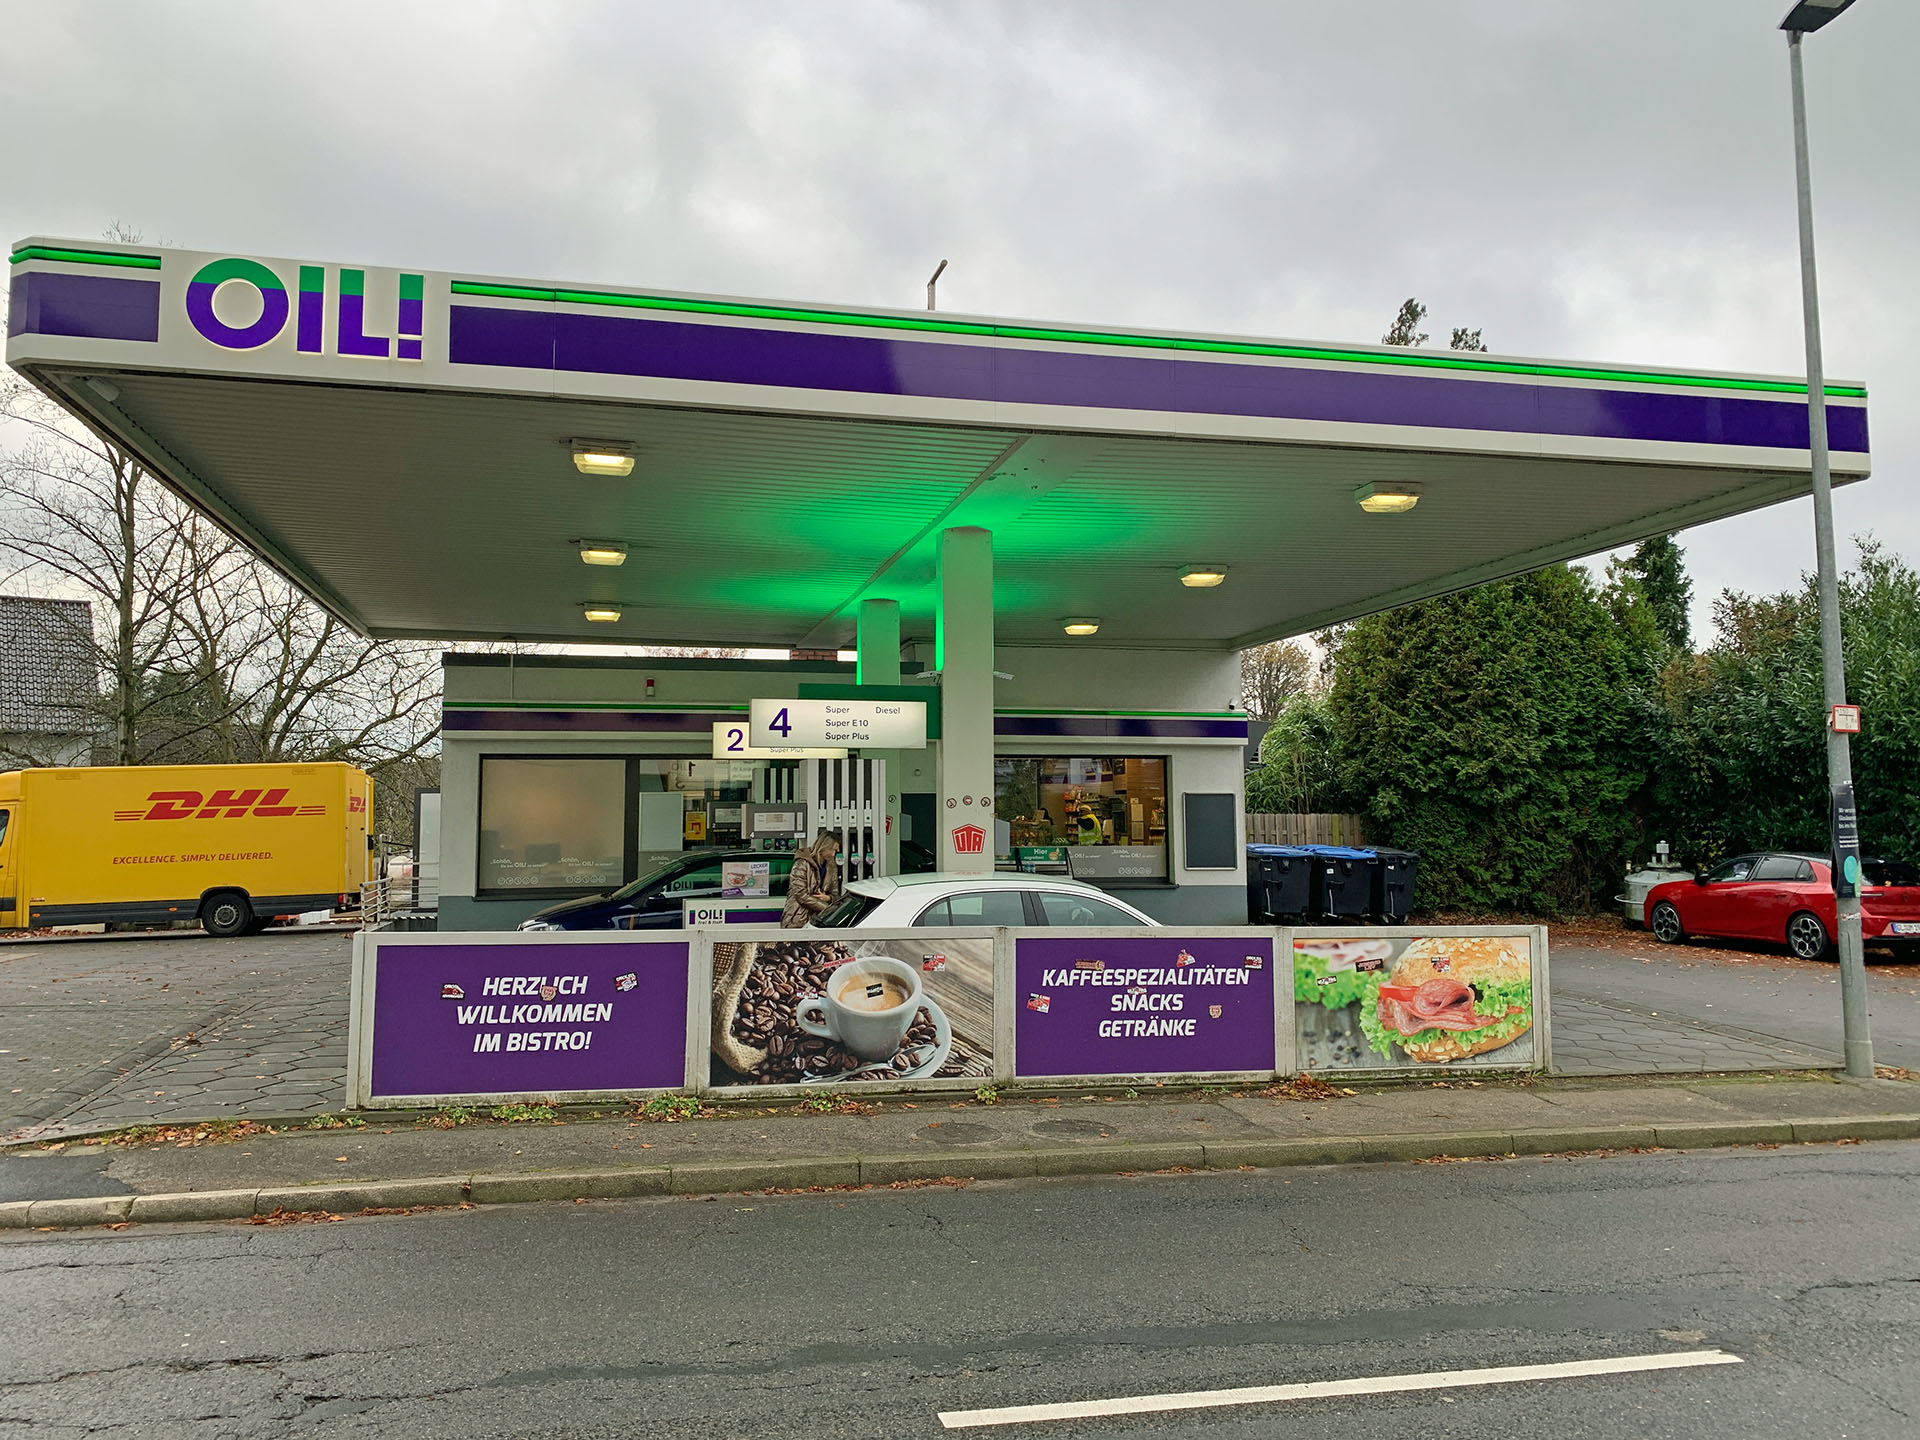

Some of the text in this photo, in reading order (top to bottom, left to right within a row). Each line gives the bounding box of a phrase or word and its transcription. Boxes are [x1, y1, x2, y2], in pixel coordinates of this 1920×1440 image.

[186, 257, 424, 361] OIL!
[825, 705, 850, 714] Super
[875, 706, 900, 714] Diesel
[768, 707, 792, 738] 4
[825, 719, 850, 728] Super
[727, 728, 744, 751] 2
[825, 732, 870, 741] Super Plus
[143, 788, 298, 820] DHL
[952, 825, 985, 853] UTA
[112, 851, 274, 865] EXCELLENCE. SIMPLY DELIVERED.
[698, 909, 723, 920] OIL!
[1042, 964, 1250, 987] KAFFEESPEZIALITÄTEN
[1110, 993, 1184, 1012] SNACKS
[457, 1003, 613, 1025] WILLKOMMEN
[1098, 1015, 1197, 1038] GETRÄNKE
[473, 1031, 593, 1053] IM BISTRO!
